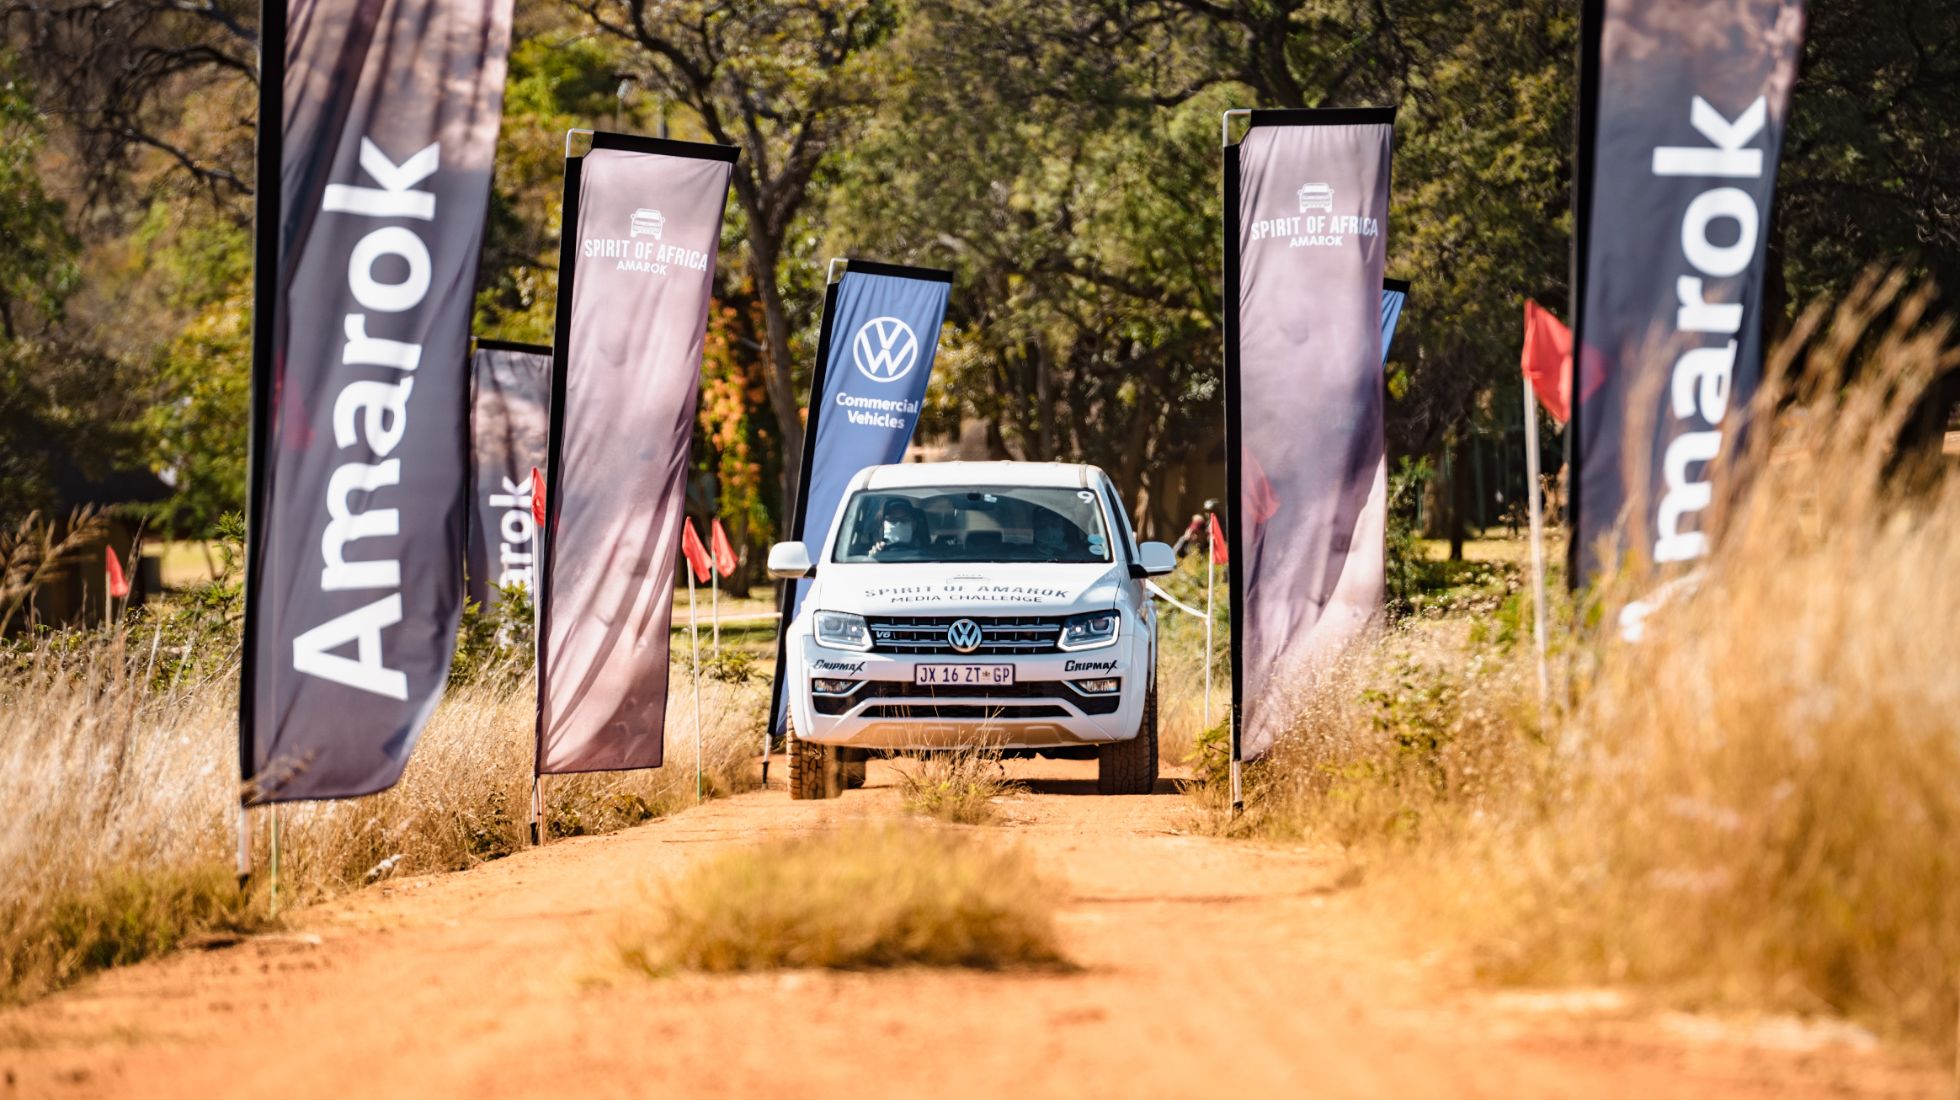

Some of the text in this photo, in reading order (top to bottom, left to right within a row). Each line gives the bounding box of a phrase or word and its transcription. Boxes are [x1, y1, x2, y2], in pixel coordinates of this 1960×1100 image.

[1251, 215, 1379, 241] SPIRIT OF AFRICA
[1289, 235, 1343, 248] AMAROK
[584, 239, 708, 272] SPIRIT OF AFRICA
[616, 260, 668, 275] AMAROK
[835, 392, 919, 414] Commercial
[293, 136, 440, 701] Amarok
[847, 410, 905, 429] Vehicles
[1077, 490, 1095, 504] 9
[865, 586, 933, 597] SPIRIT
[977, 585, 1069, 599] AMAROK
[890, 595, 1043, 604] MEDIA CHALLENGE
[920, 667, 1010, 683] JX 16 ZT GP
